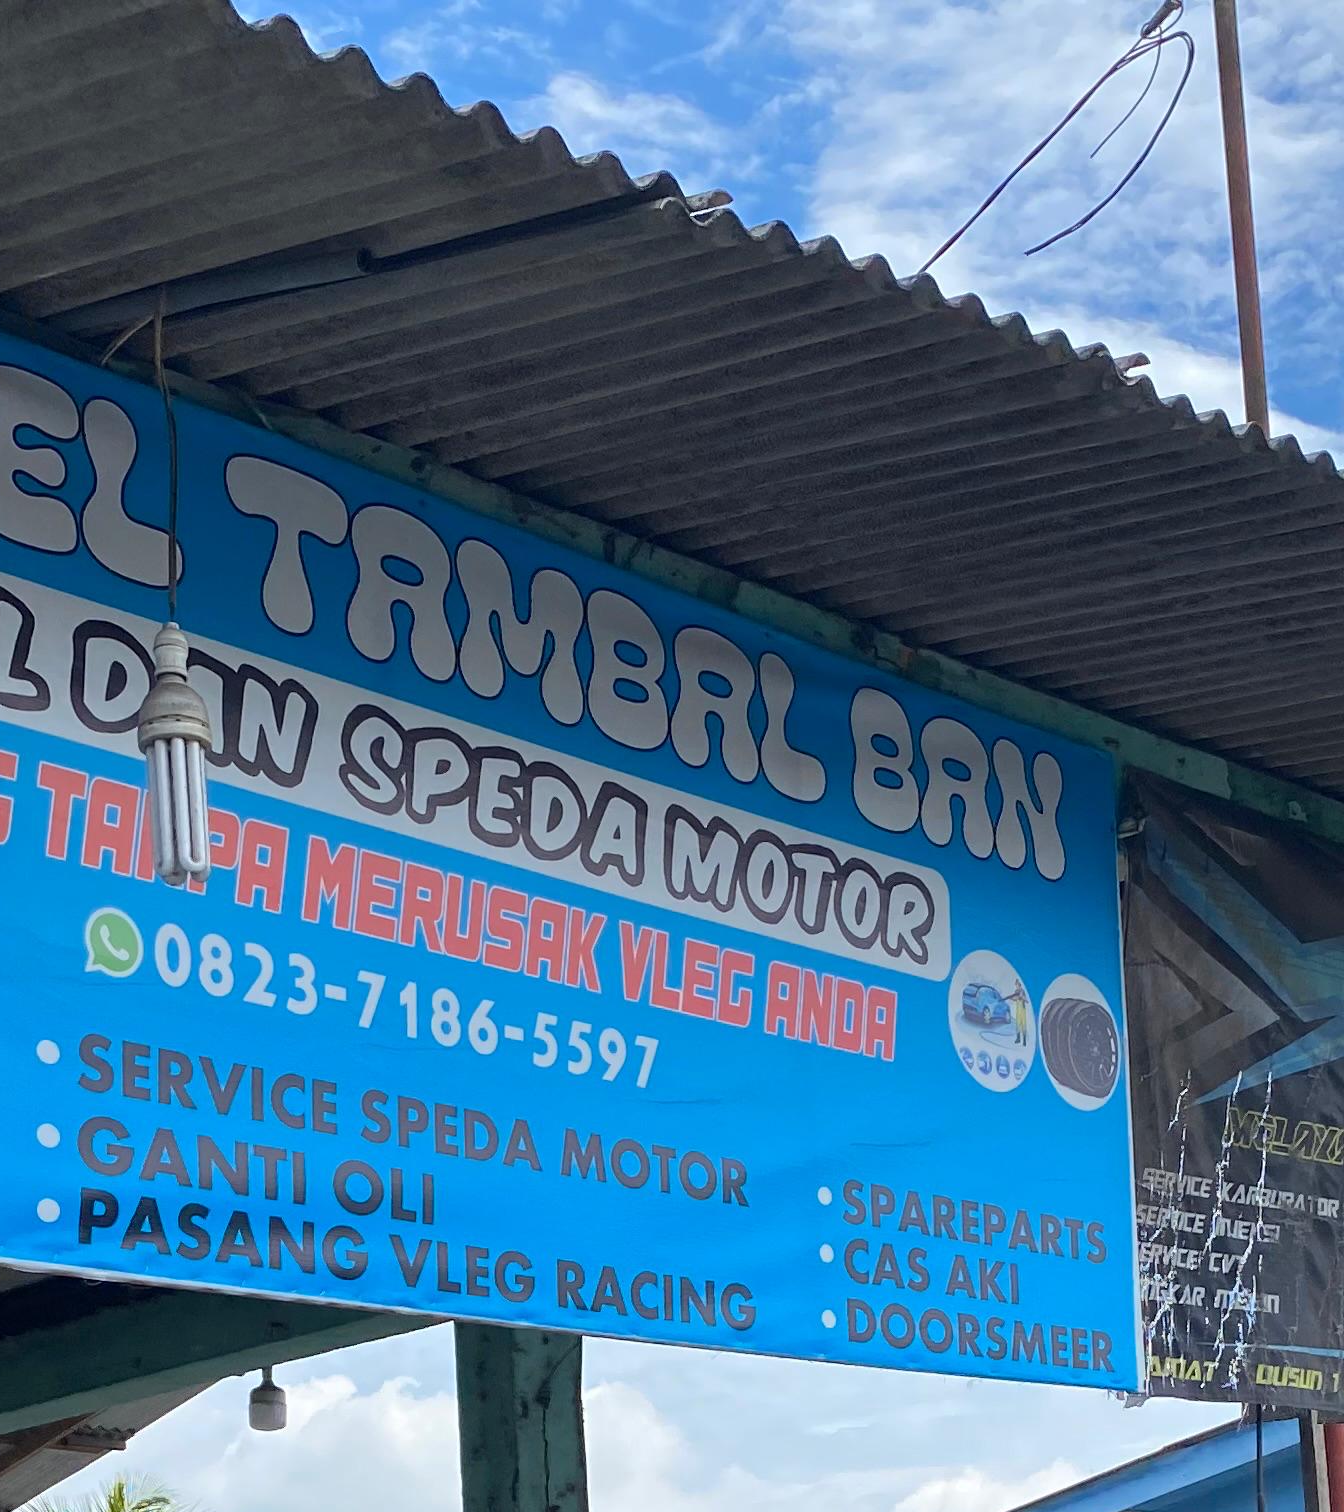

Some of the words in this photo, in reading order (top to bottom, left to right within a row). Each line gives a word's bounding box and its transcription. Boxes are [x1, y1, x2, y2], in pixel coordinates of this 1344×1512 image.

[224, 454, 826, 801] TAMBAL
[851, 685, 1064, 880] BAN
[71, 618, 318, 787] DN
[340, 704, 647, 887] SPEDA
[664, 814, 935, 965] MOTOR
[37, 761, 289, 914] TAPA
[302, 835, 606, 992] MERUSAK
[619, 917, 753, 1027] VLEG
[765, 958, 897, 1062] ANDA
[155, 923, 661, 1089] 0823-7186-5597
[78, 1033, 340, 1138] SERVICE
[360, 1090, 542, 1172] SPEDA
[560, 1134, 750, 1207] MOTOR
[78, 1116, 309, 1206] GANTI
[331, 1159, 436, 1227] OLI
[841, 1179, 1108, 1265] SPAREPARTS
[1142, 1167, 1213, 1199] SERVICE
[78, 1188, 369, 1280] PASANG
[388, 1232, 535, 1304] VLEG
[557, 1261, 758, 1331] RACING
[843, 1239, 930, 1293] CAS
[952, 1255, 1022, 1306] AKI
[1139, 1242, 1202, 1270] ERVICE
[847, 1298, 1116, 1373] DOORSMEER
[1256, 1364, 1322, 1390] DUSUN
